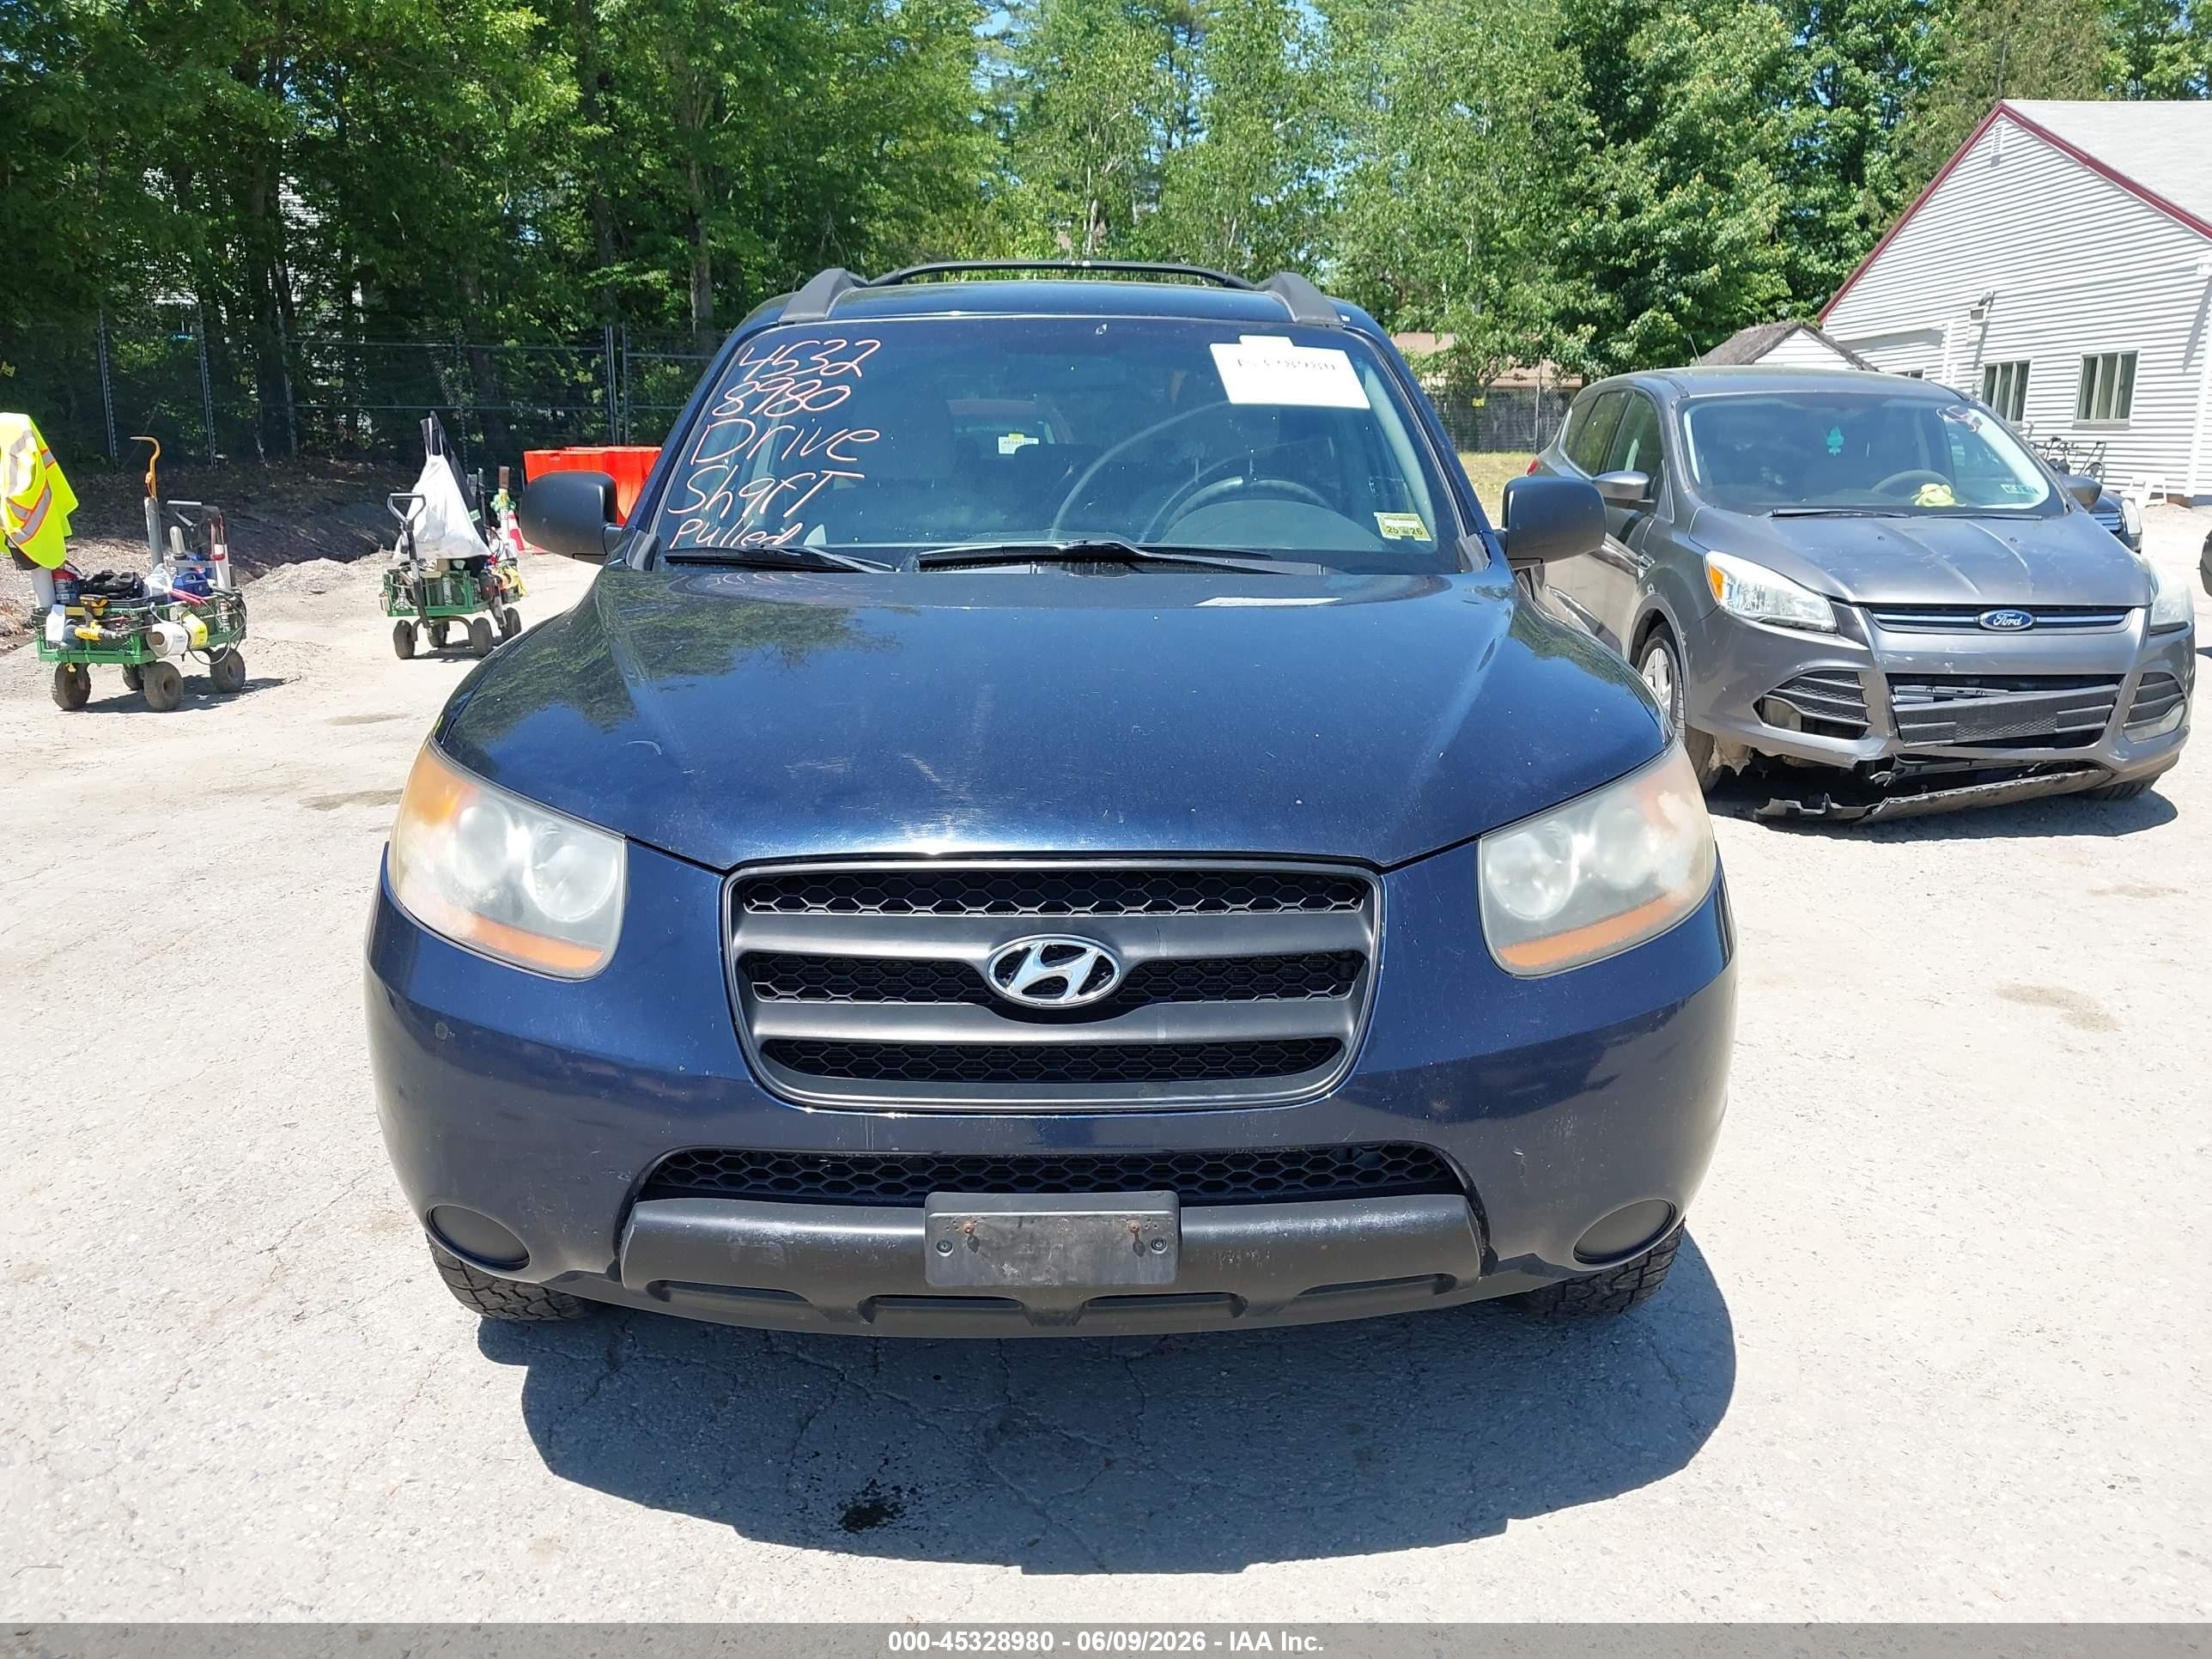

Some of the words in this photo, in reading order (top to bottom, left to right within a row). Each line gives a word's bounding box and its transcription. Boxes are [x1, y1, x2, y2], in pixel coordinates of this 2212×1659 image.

[739, 339, 881, 382] 4532
[712, 377, 852, 417] 8980
[690, 418, 880, 465] Drive
[1386, 526, 1400, 534] 25
[1409, 527, 1423, 536] 26
[1992, 612, 2023, 626] Ford
